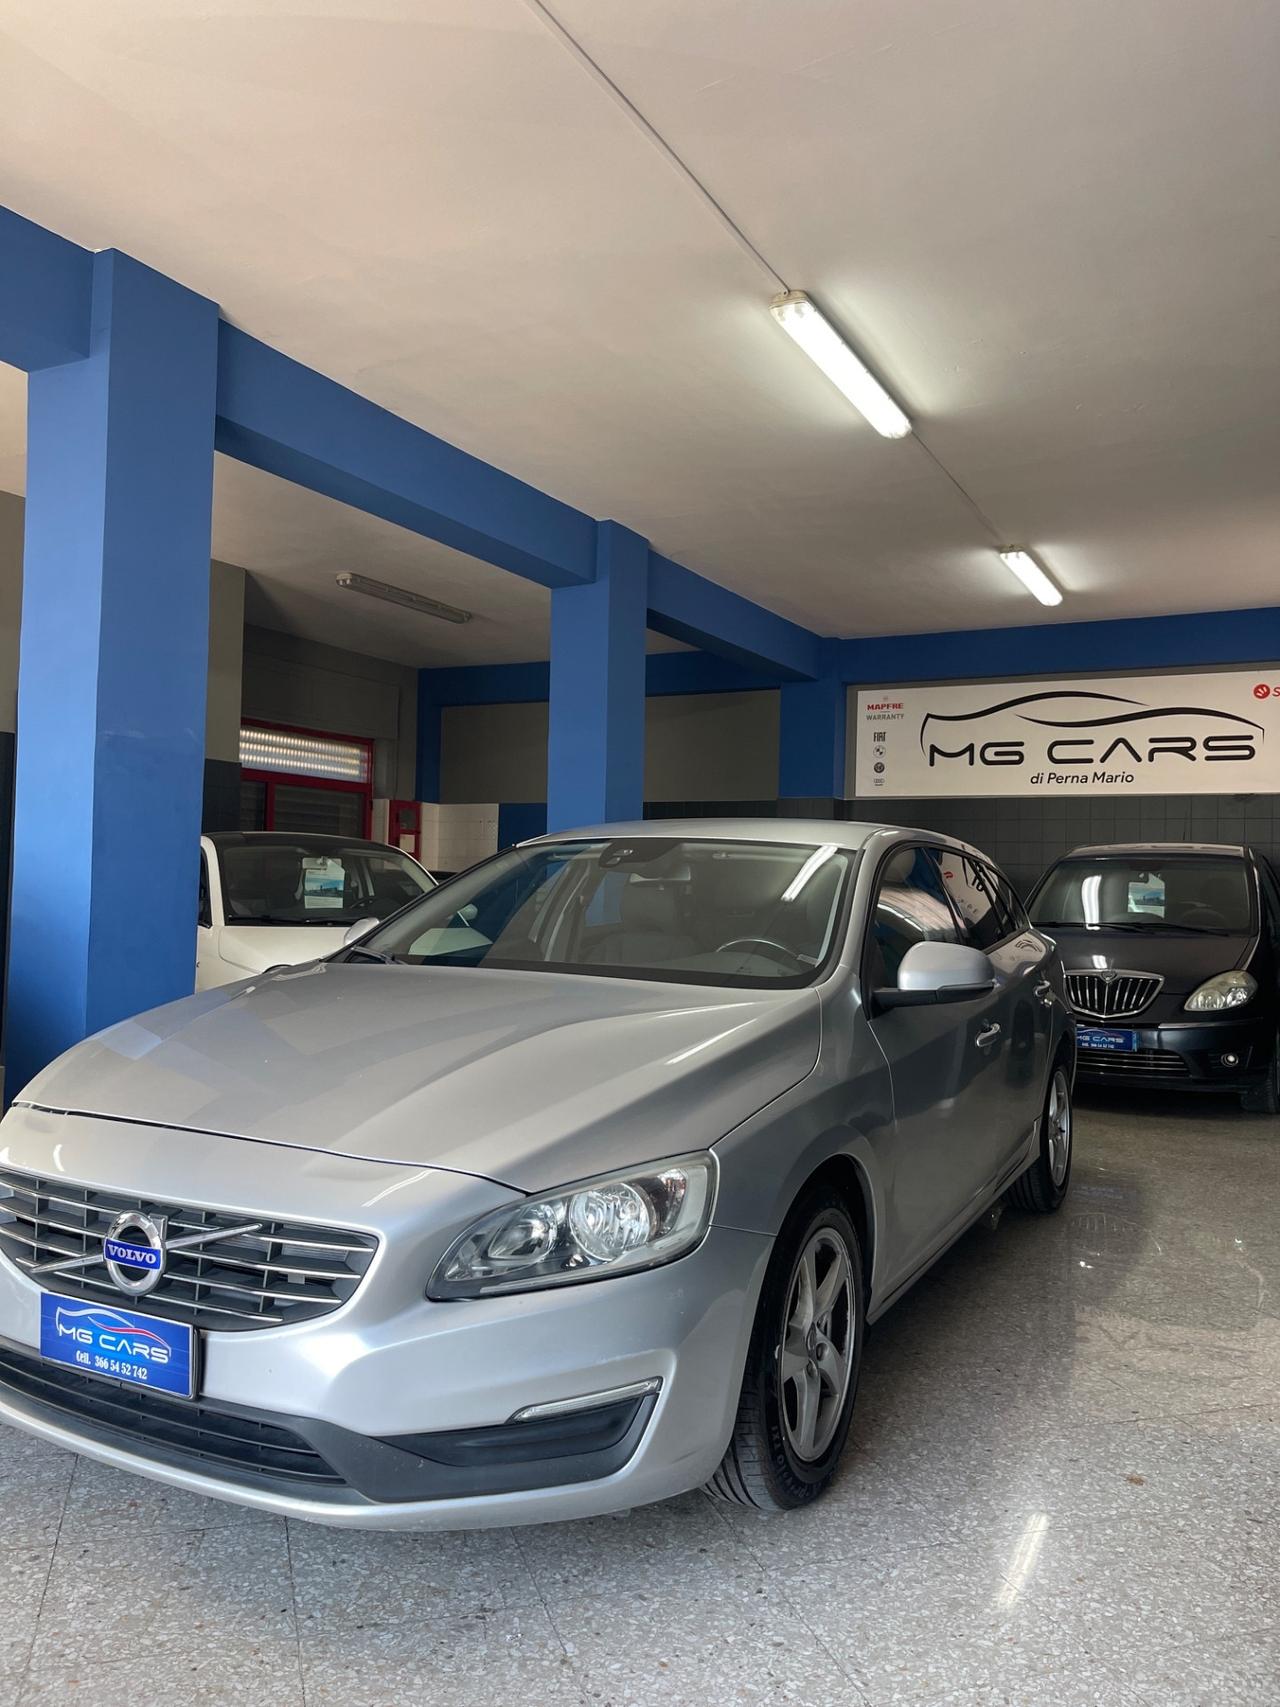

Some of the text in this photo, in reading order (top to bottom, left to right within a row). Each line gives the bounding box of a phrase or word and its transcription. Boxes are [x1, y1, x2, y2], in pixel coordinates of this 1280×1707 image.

[867, 702, 904, 711] MAPFRE
[873, 731, 886, 742] FIAT
[929, 734, 1256, 767] MG CARS
[1030, 770, 1135, 785] di Perna Mario
[107, 1244, 156, 1264] VOLVO
[59, 1323, 169, 1364] MG CARS
[95, 1355, 109, 1370] 366
[110, 1359, 120, 1374] 54
[121, 1362, 131, 1376] 52
[133, 1365, 148, 1380] 742
